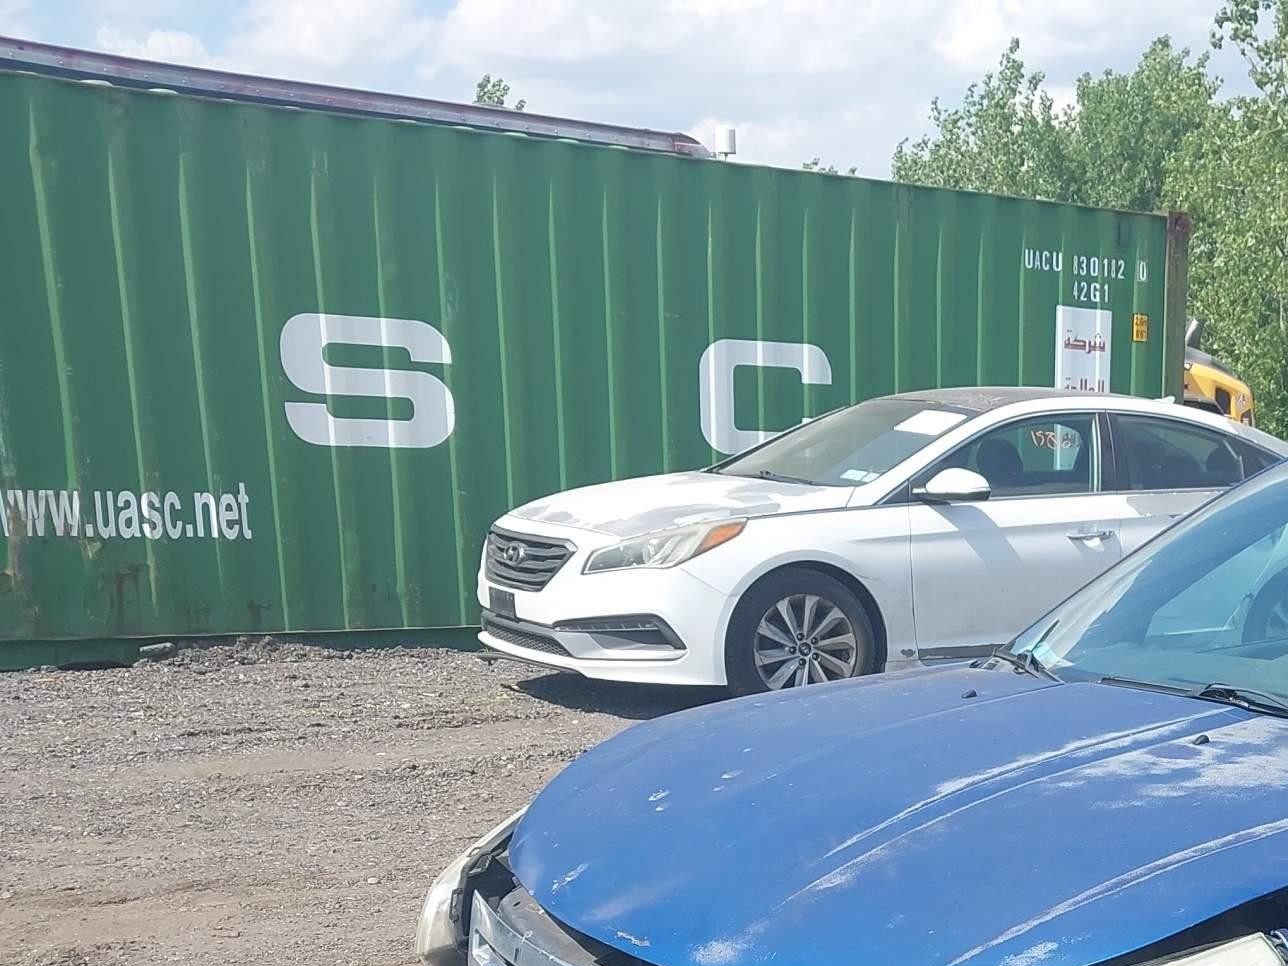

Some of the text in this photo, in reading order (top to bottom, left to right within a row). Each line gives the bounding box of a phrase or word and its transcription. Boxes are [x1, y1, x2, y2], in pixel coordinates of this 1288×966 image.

[1024, 248, 1063, 271] UACU
[1072, 255, 1125, 279] 830182
[1072, 280, 1109, 303] 42G1
[279, 312, 833, 455] S C
